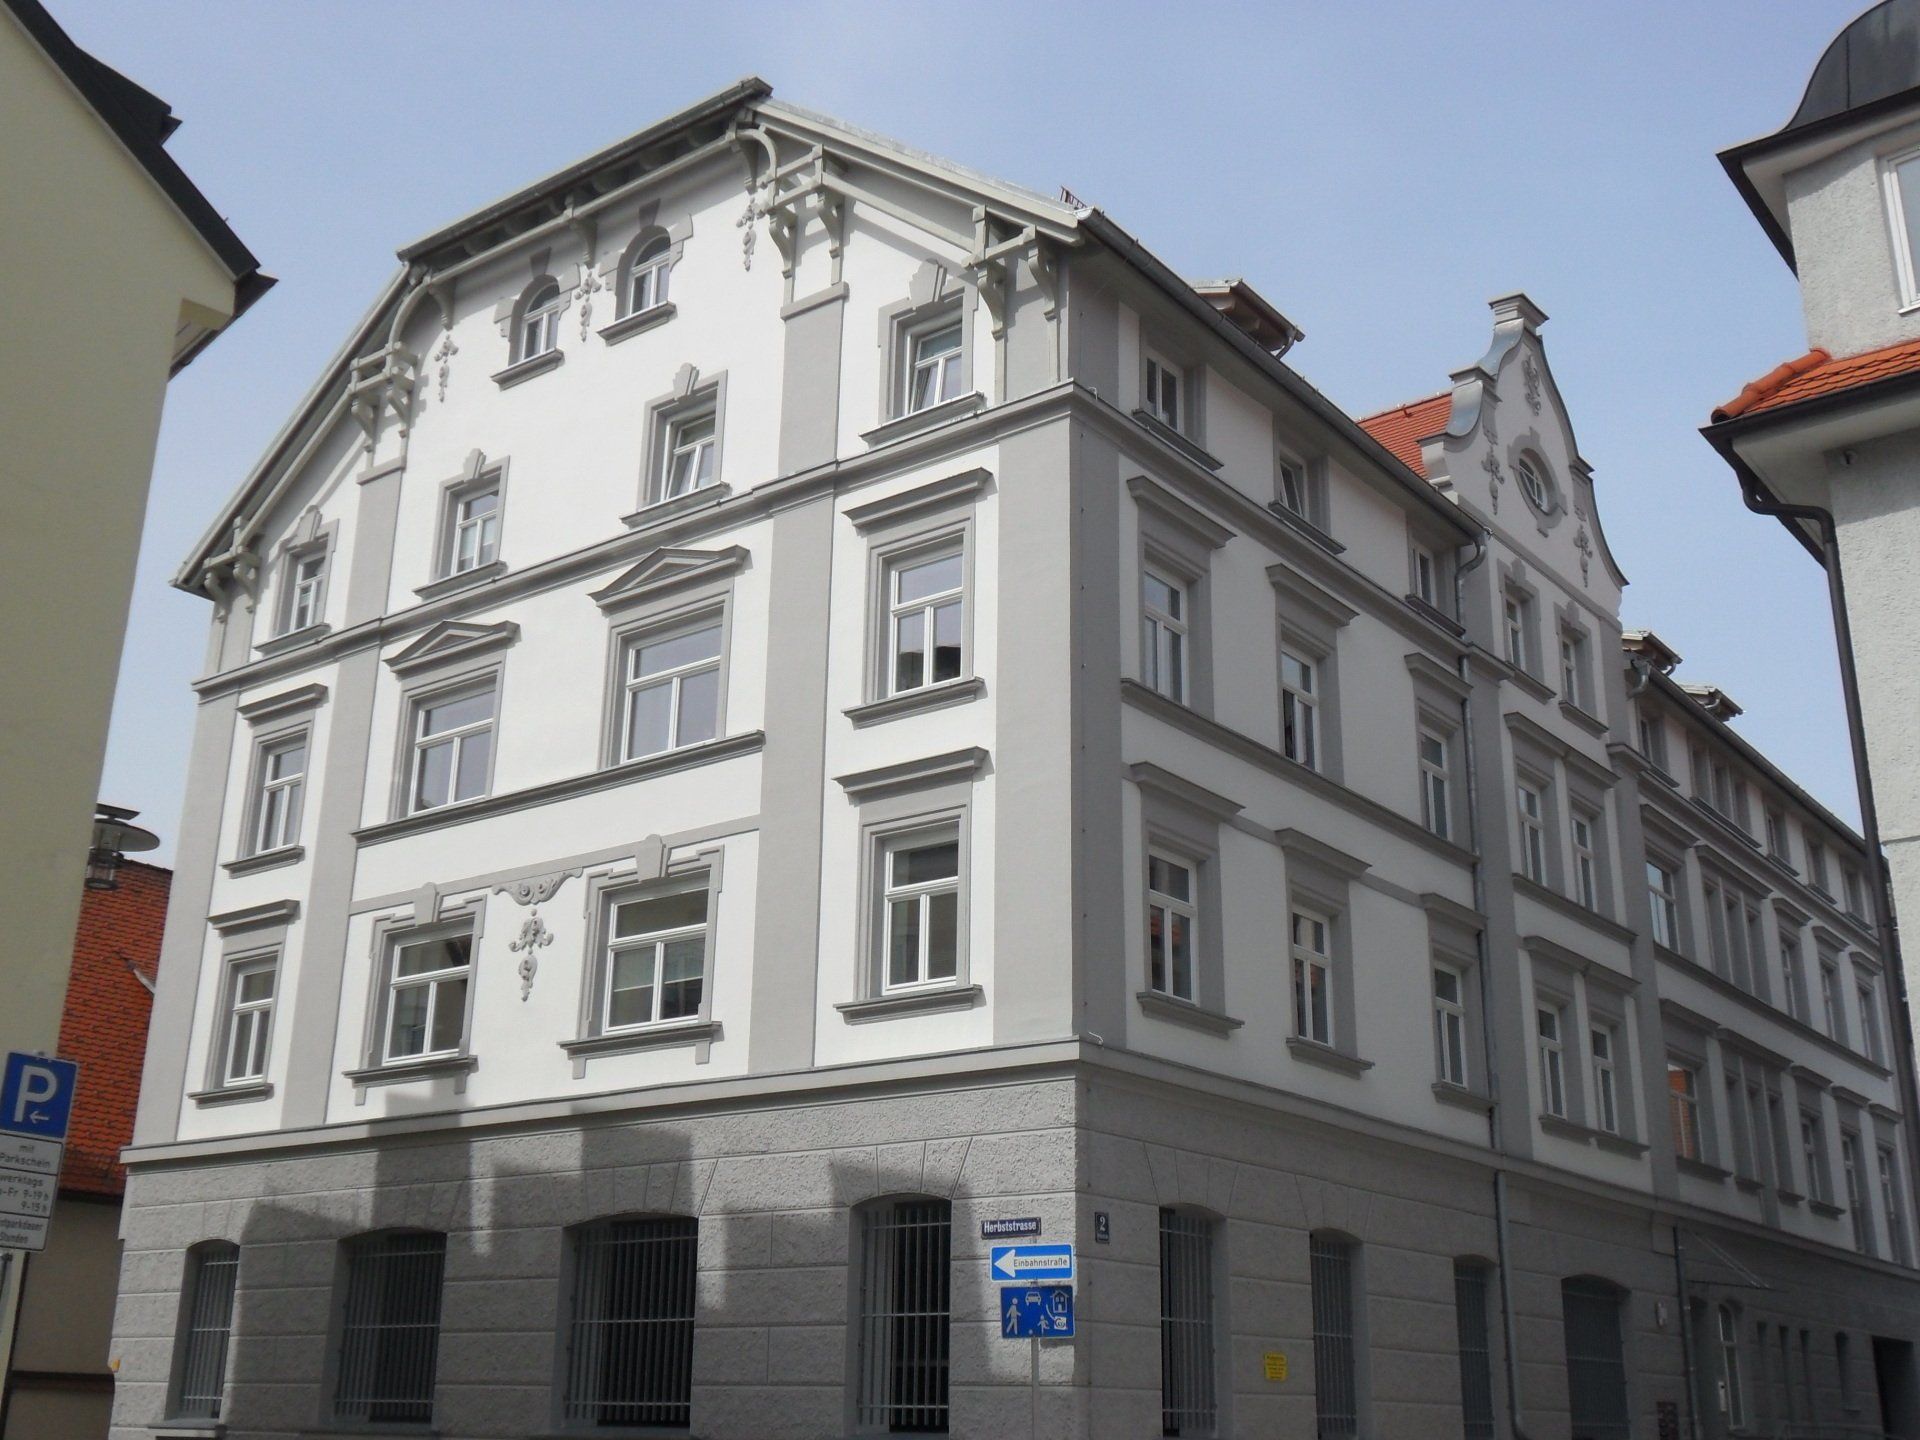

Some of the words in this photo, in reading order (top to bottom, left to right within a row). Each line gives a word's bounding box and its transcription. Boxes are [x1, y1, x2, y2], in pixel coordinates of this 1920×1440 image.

[14, 1065, 58, 1123] P
[984, 1221, 1037, 1233] Herbststrasse
[1100, 1216, 1106, 1231] 2
[1013, 1257, 1068, 1267] Einbahnstraße
